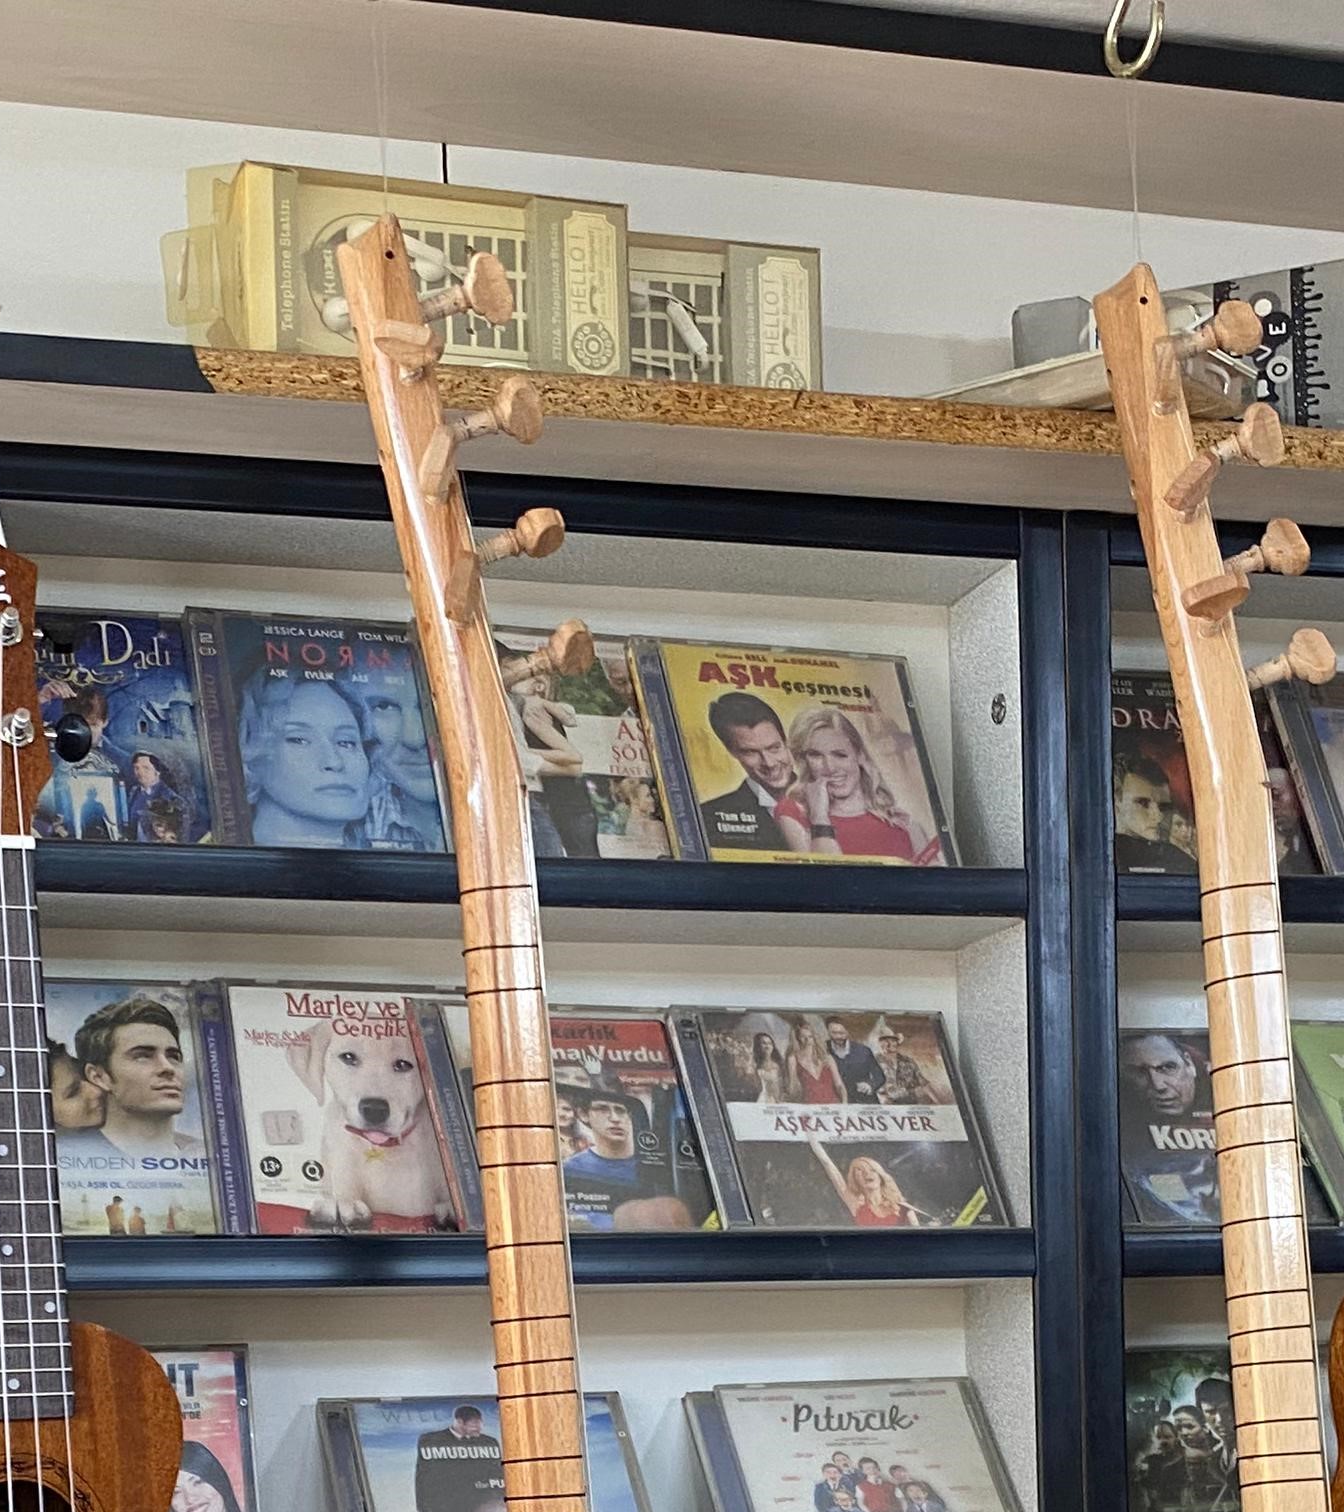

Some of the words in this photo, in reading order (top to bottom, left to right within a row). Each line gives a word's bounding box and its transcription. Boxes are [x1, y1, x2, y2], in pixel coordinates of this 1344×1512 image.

[281, 250, 293, 331] Telephone
[308, 628, 345, 640] LANGE
[358, 631, 383, 643] TOM
[699, 661, 780, 689] AŞK
[284, 991, 368, 1018] Marley
[331, 1017, 408, 1041] Gençlik
[832, 1114, 889, 1138] ŞANS
[890, 1114, 939, 1133] VER
[420, 1445, 501, 1462] UMUDUNU
